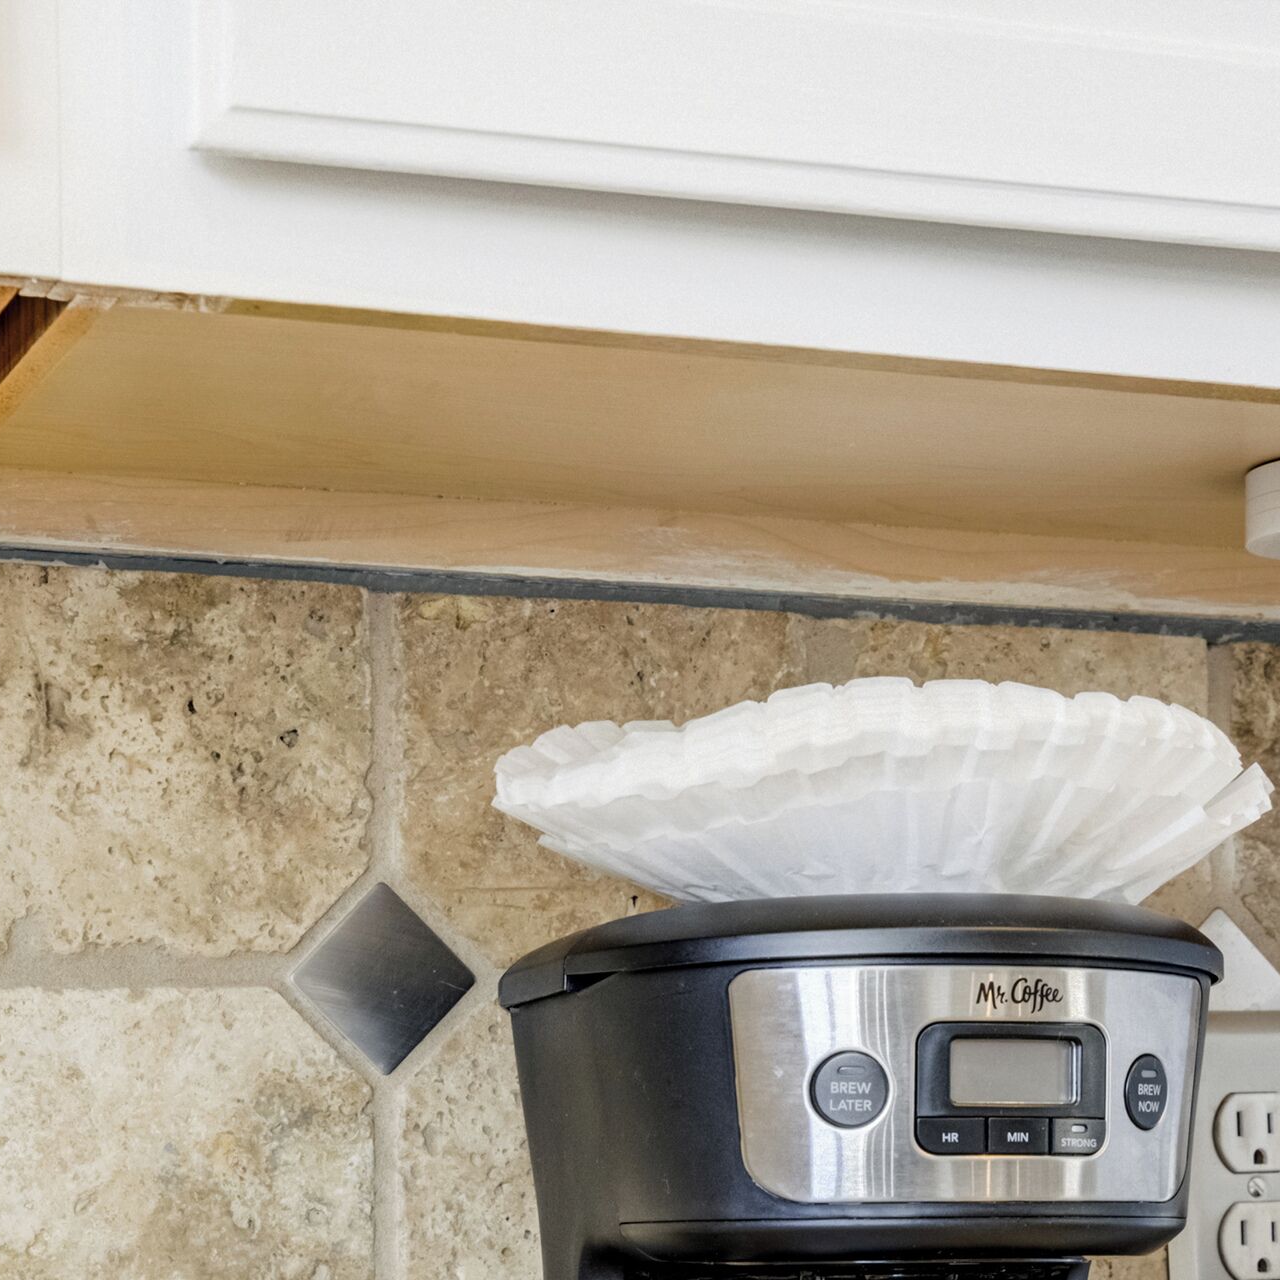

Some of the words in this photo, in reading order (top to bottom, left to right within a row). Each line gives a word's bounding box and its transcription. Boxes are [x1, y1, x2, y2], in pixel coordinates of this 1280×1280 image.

[976, 981, 1008, 1009] Mr.
[1011, 977, 1063, 1014] Coffee
[830, 1081, 872, 1095] BREW
[1137, 1083, 1162, 1096] BREW
[830, 1099, 873, 1112] LATER
[1138, 1100, 1161, 1113] NOW
[941, 1132, 959, 1143] HR
[1006, 1131, 1029, 1143] MIN
[1060, 1137, 1097, 1148] STRONG
